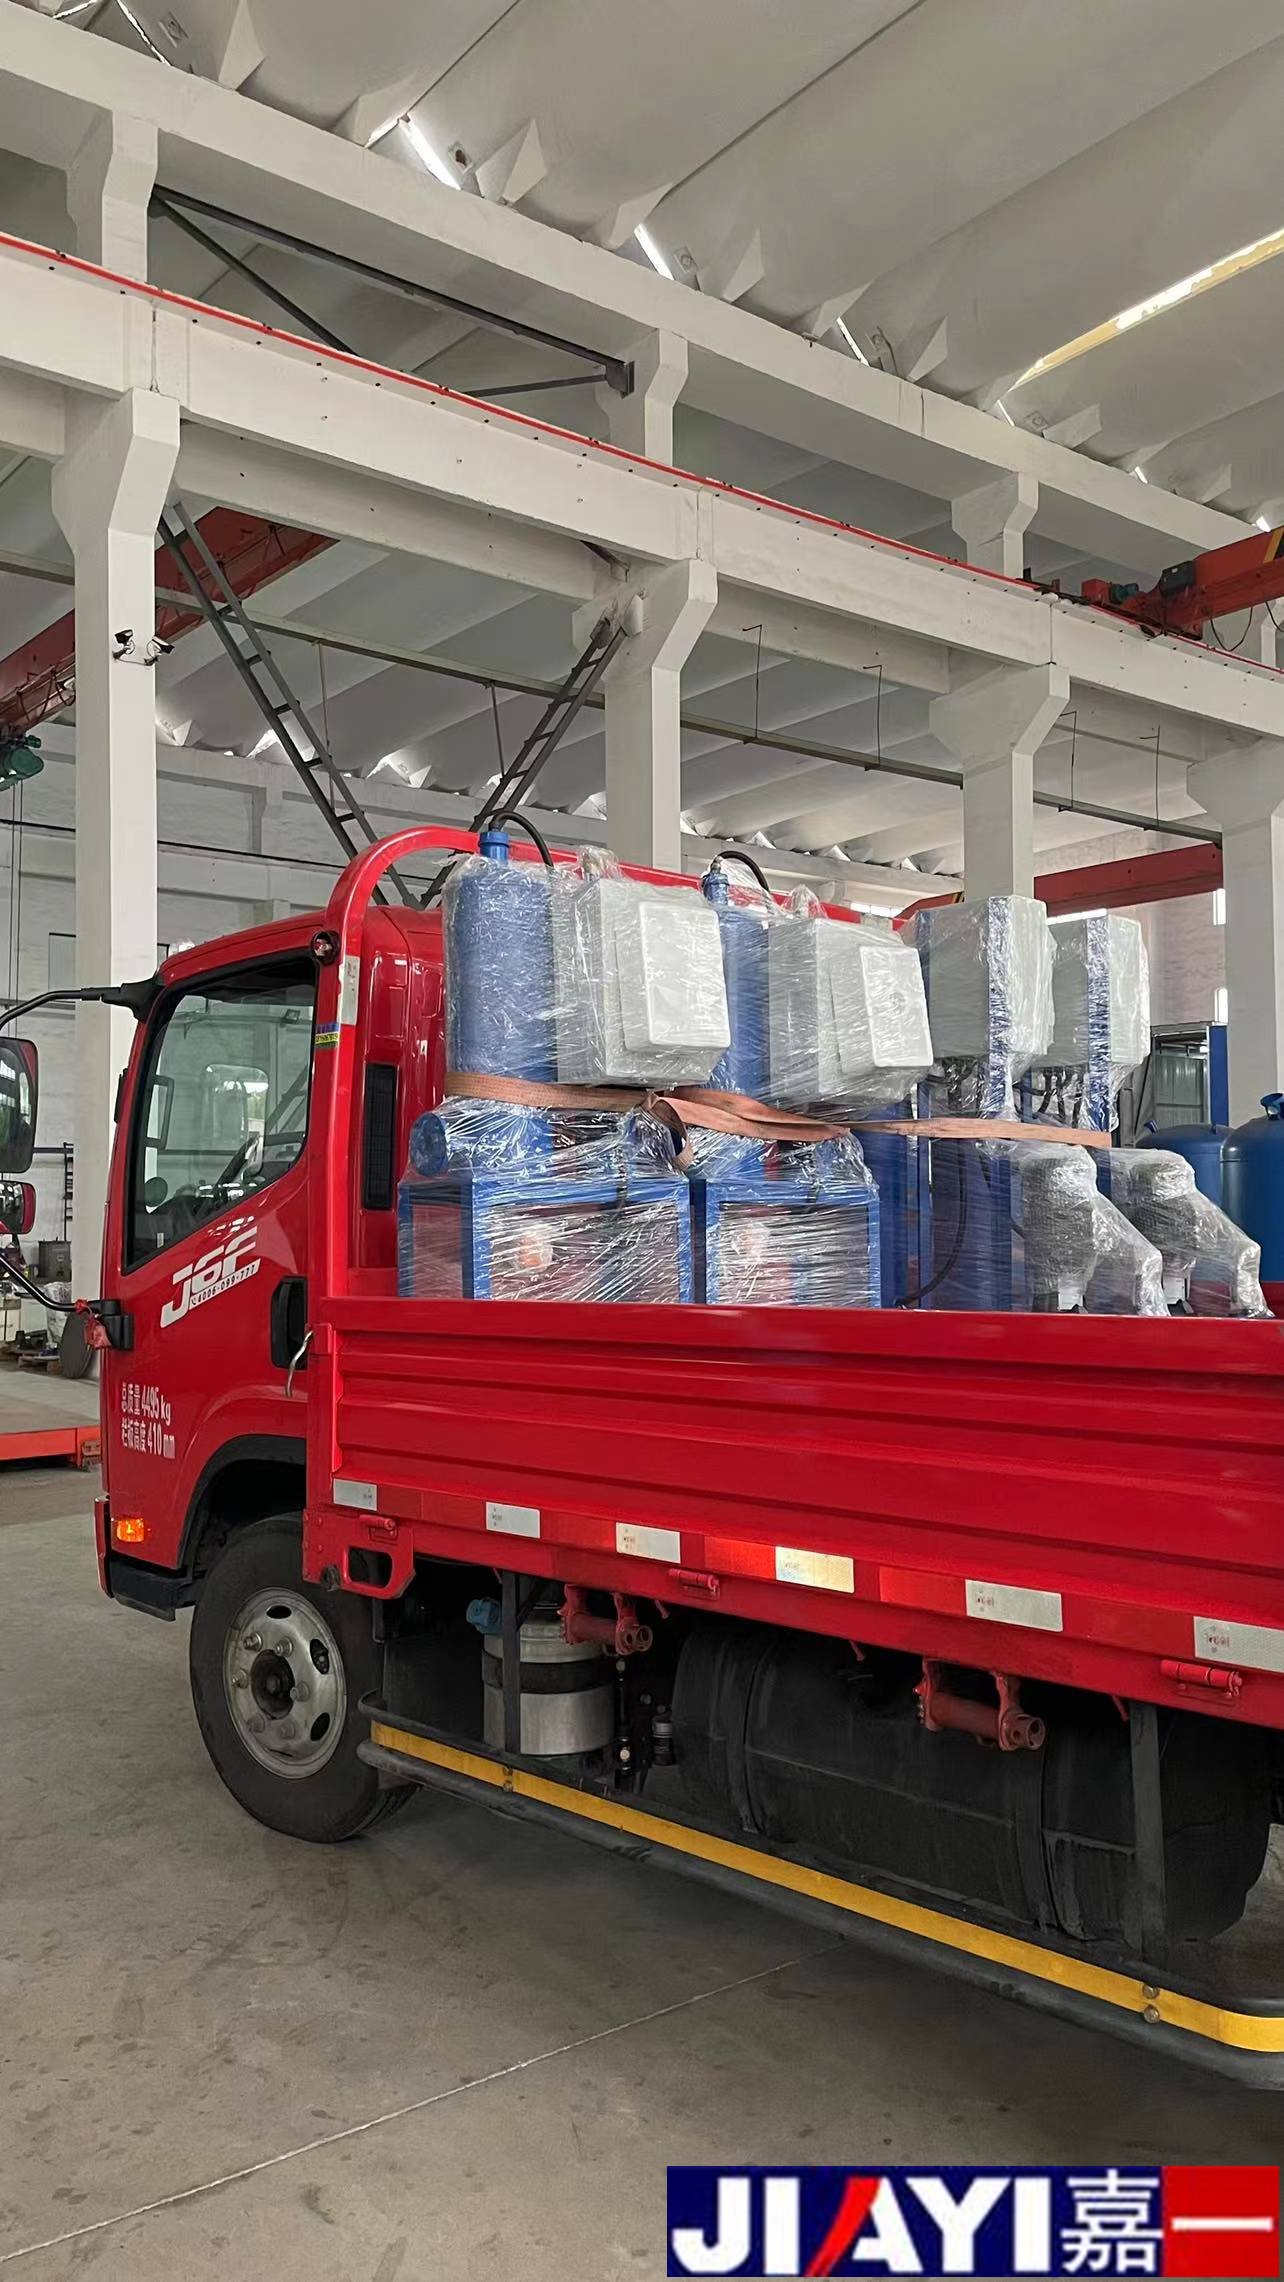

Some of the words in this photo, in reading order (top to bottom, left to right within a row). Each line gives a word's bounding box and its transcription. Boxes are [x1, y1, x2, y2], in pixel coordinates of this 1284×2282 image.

[198, 1264, 256, 1303] 4006-099-777
[141, 1385, 160, 1419] 4495
[160, 1394, 171, 1426] kg
[147, 1421, 162, 1455] 410
